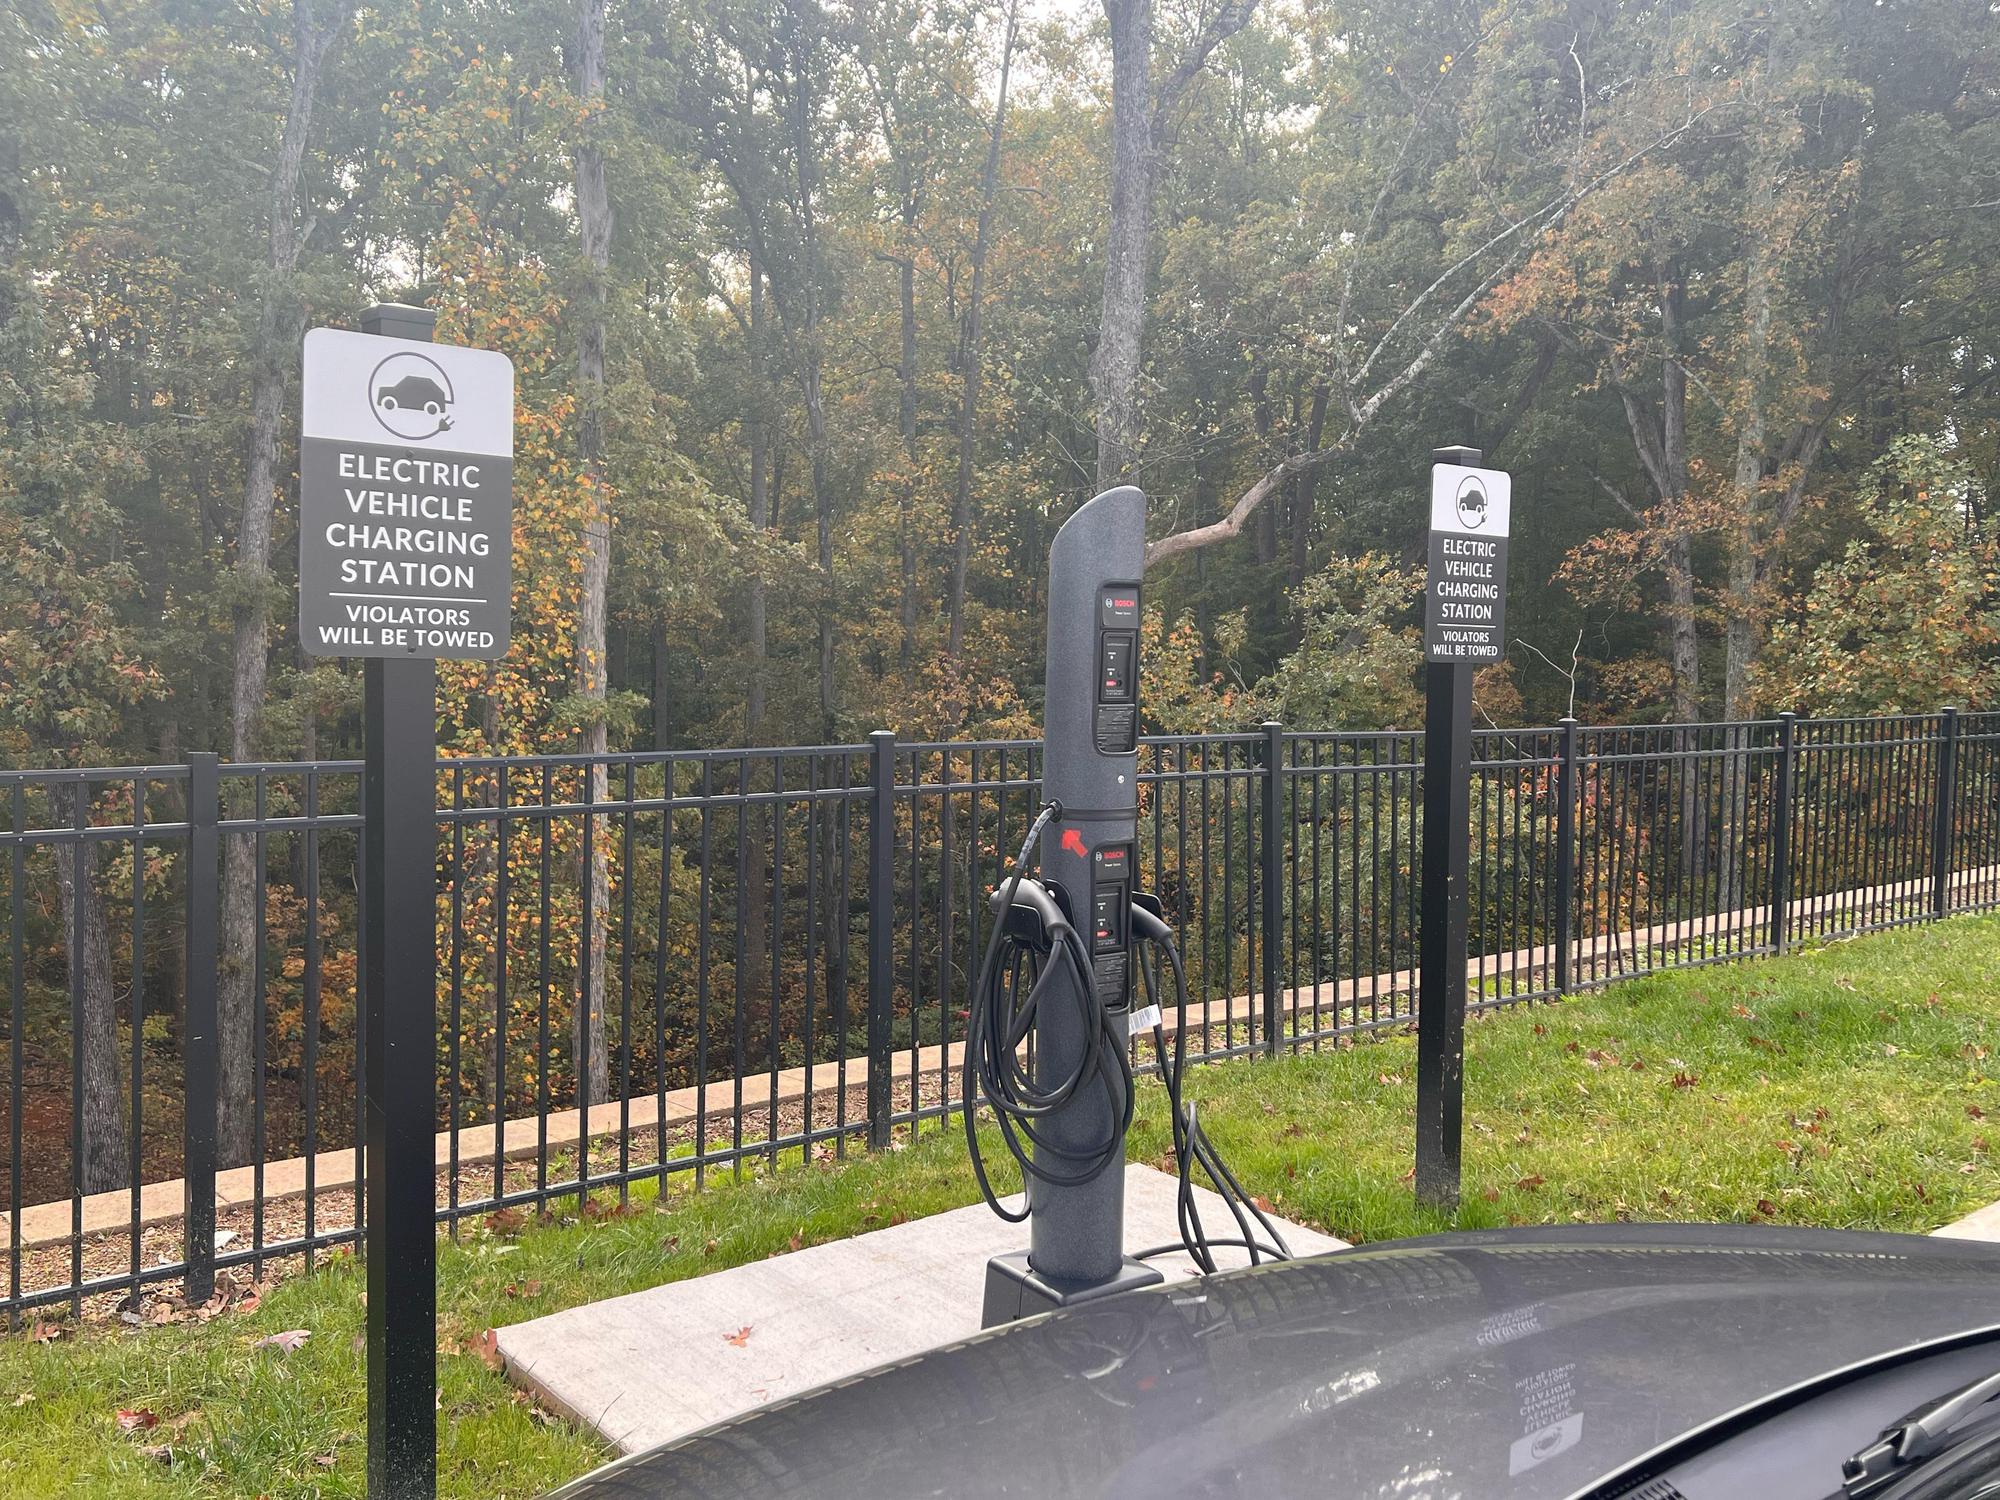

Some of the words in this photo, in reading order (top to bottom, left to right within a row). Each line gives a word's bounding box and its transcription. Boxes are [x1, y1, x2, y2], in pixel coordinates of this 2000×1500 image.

[338, 453, 481, 489] ELECTRIC
[344, 488, 473, 522] VEHICLE
[325, 522, 490, 557] CHARGING
[1443, 538, 1497, 558] ELECTRIC
[340, 558, 475, 590] STATION
[1444, 560, 1493, 579] VEHICLE
[1437, 581, 1499, 600] CHARGING
[1114, 599, 1136, 608] BOSCH
[1441, 602, 1493, 620] STATION
[345, 604, 471, 626] VIOLATORS
[318, 626, 374, 646] WILL
[381, 627, 408, 646] BE
[413, 629, 494, 649] TOWED
[1442, 630, 1490, 643] VIOLATORS
[1432, 644, 1454, 656] WILL
[1456, 645, 1466, 656] BE
[1467, 645, 1498, 657] TOWED
[1103, 850, 1125, 859] BOSCH
